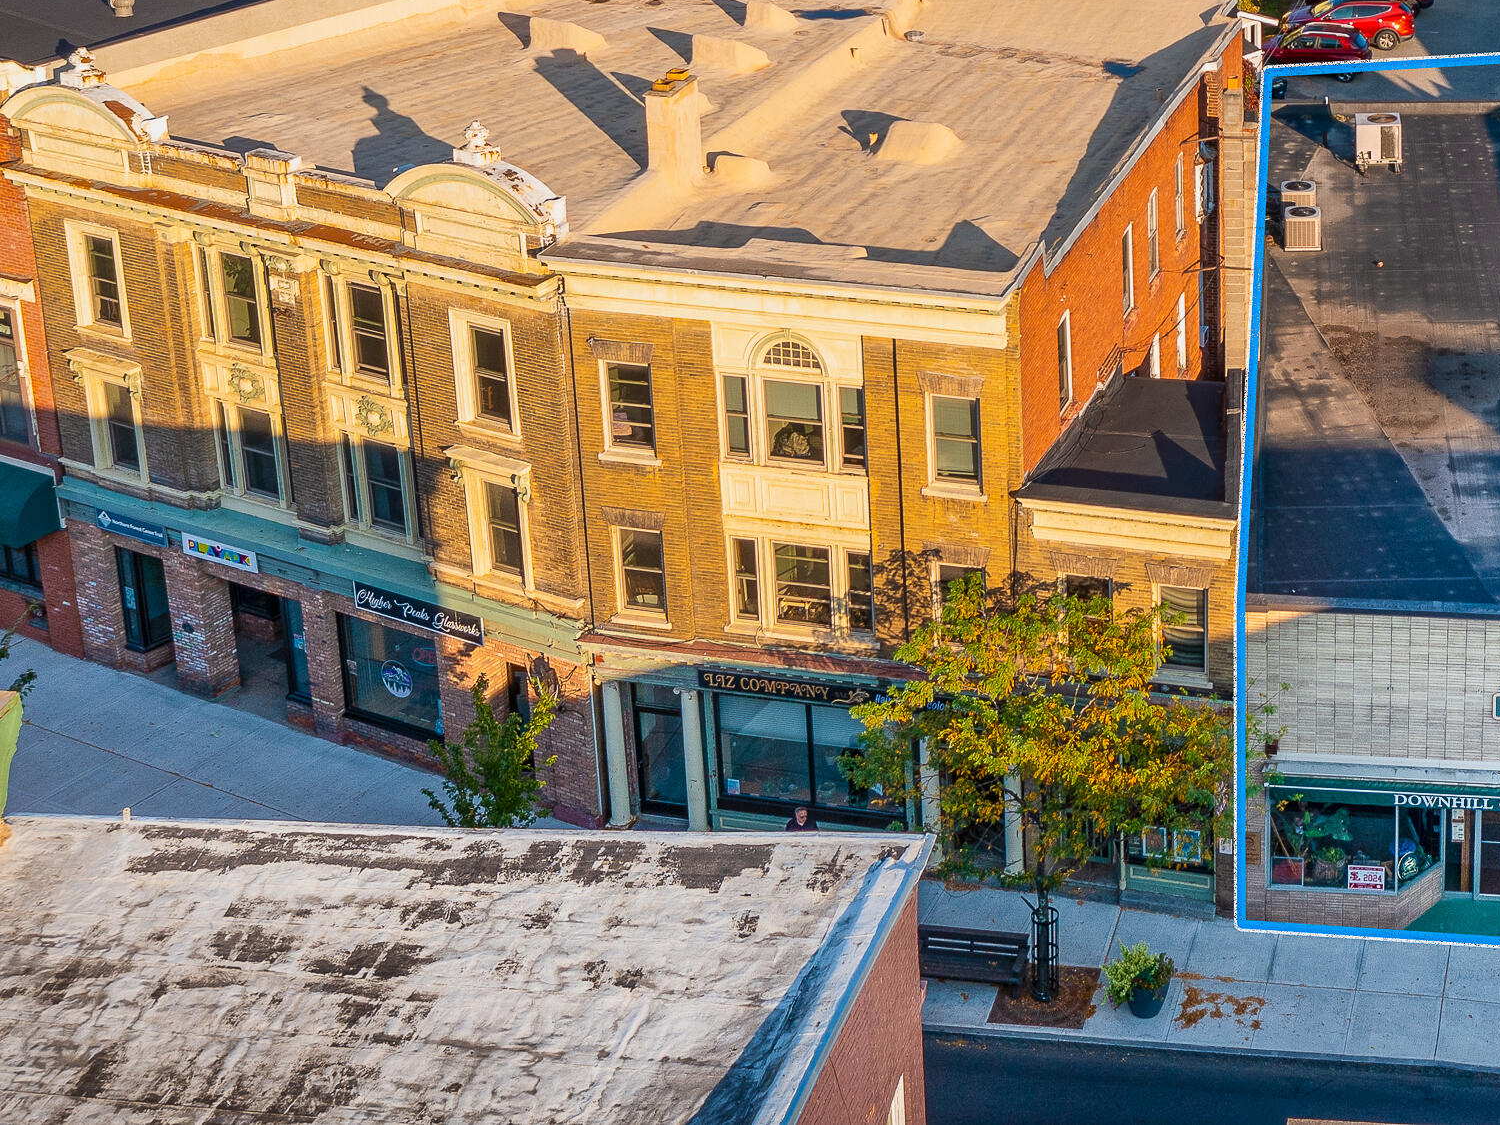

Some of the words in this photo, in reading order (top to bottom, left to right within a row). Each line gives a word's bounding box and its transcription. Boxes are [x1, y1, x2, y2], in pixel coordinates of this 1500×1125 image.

[357, 589, 392, 609] Higher
[394, 600, 430, 621] Peaks
[432, 612, 481, 637] Glassworks
[704, 673, 736, 688] LIZ
[740, 677, 830, 700] COMPANY
[1394, 794, 1493, 810] DOWNHILL
[1363, 873, 1382, 883] 2024
